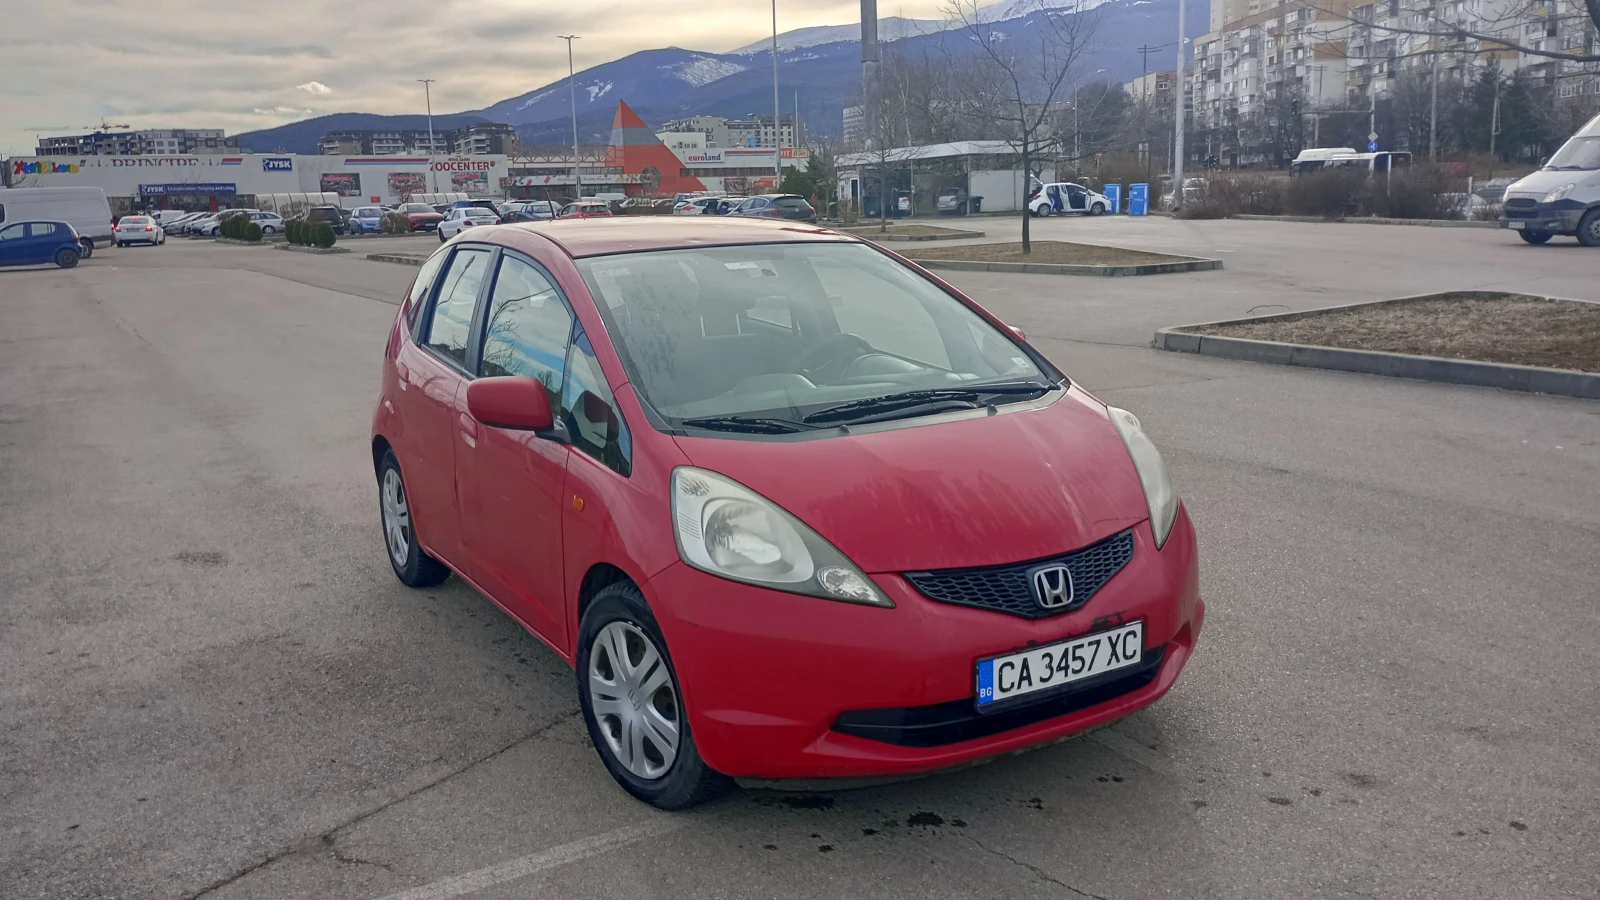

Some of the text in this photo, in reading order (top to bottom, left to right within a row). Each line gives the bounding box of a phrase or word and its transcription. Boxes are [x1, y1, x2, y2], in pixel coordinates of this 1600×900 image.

[688, 152, 721, 161] euroland
[269, 160, 291, 168] JYSK
[998, 629, 1138, 693] CA 3457 XC
[980, 686, 992, 698] BG
